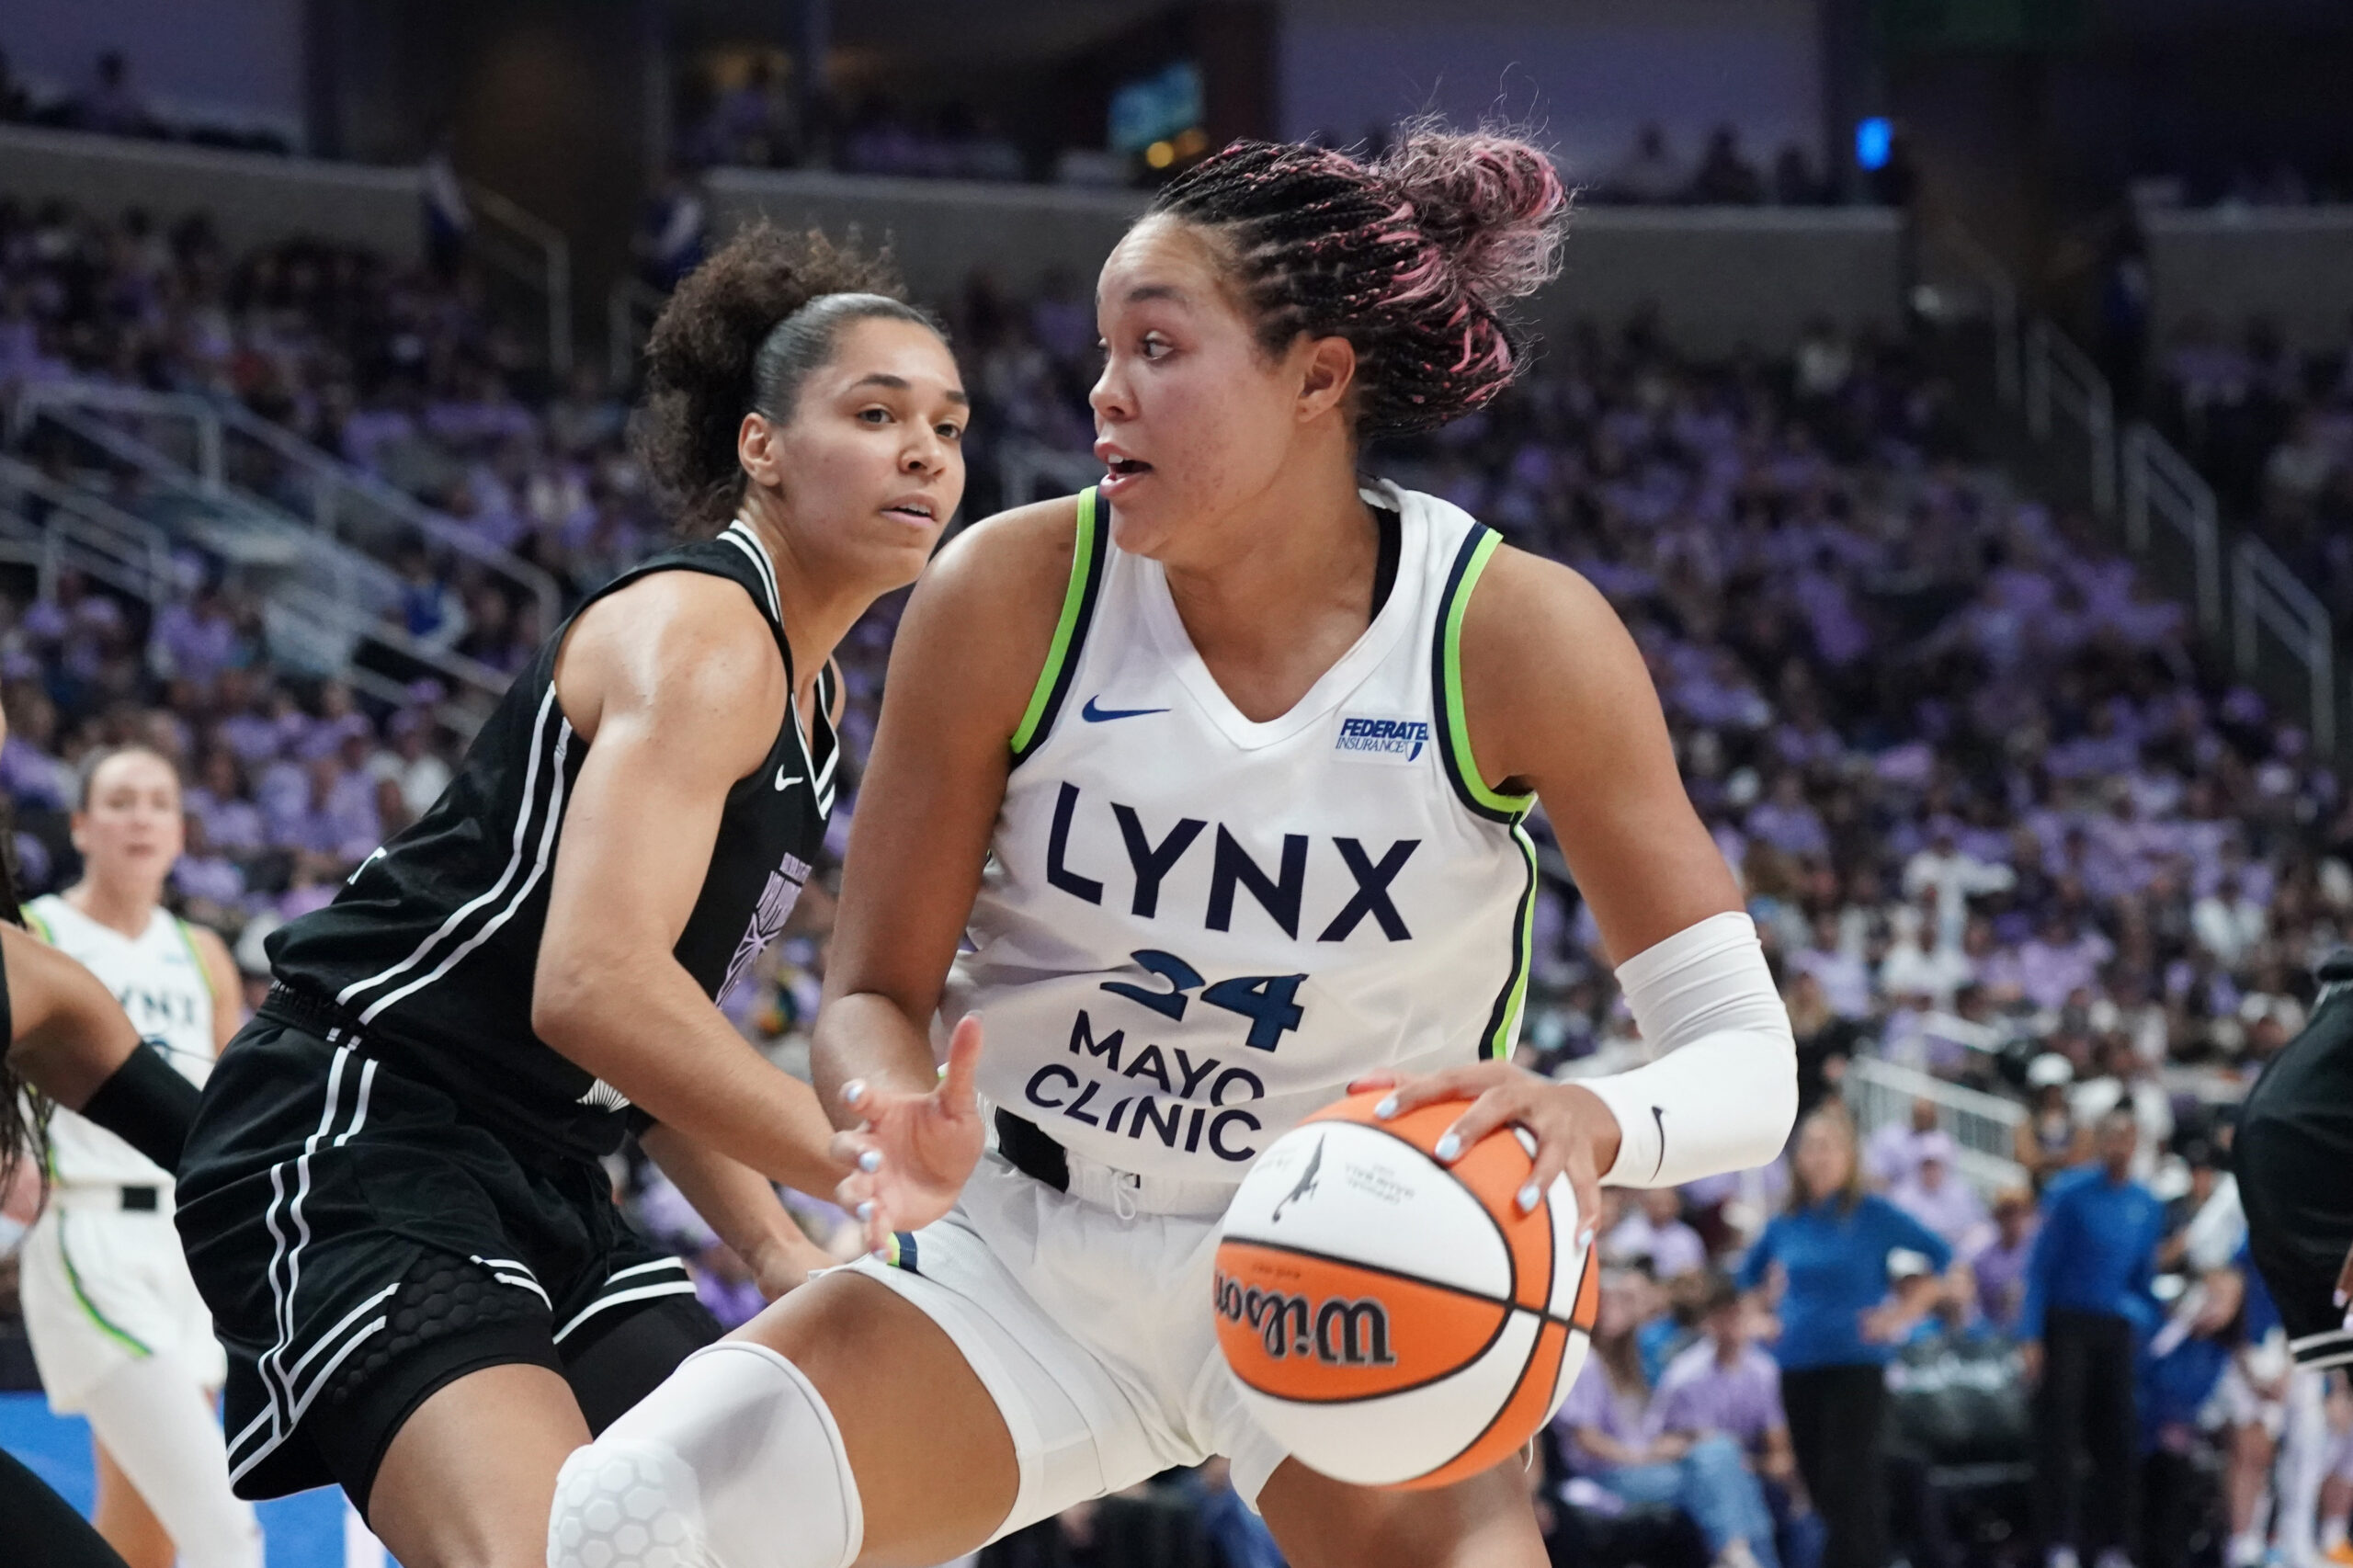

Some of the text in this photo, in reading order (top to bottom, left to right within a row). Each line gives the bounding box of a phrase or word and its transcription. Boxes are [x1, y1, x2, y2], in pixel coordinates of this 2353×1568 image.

[1336, 736, 1405, 754] INSURANCE
[1340, 718, 1428, 741] FEDERATE
[1047, 781, 1422, 943] LYNX
[1100, 949, 1309, 1052] 24
[1069, 1009, 1264, 1107] MAYO
[1025, 1063, 1262, 1162] CLINIC
